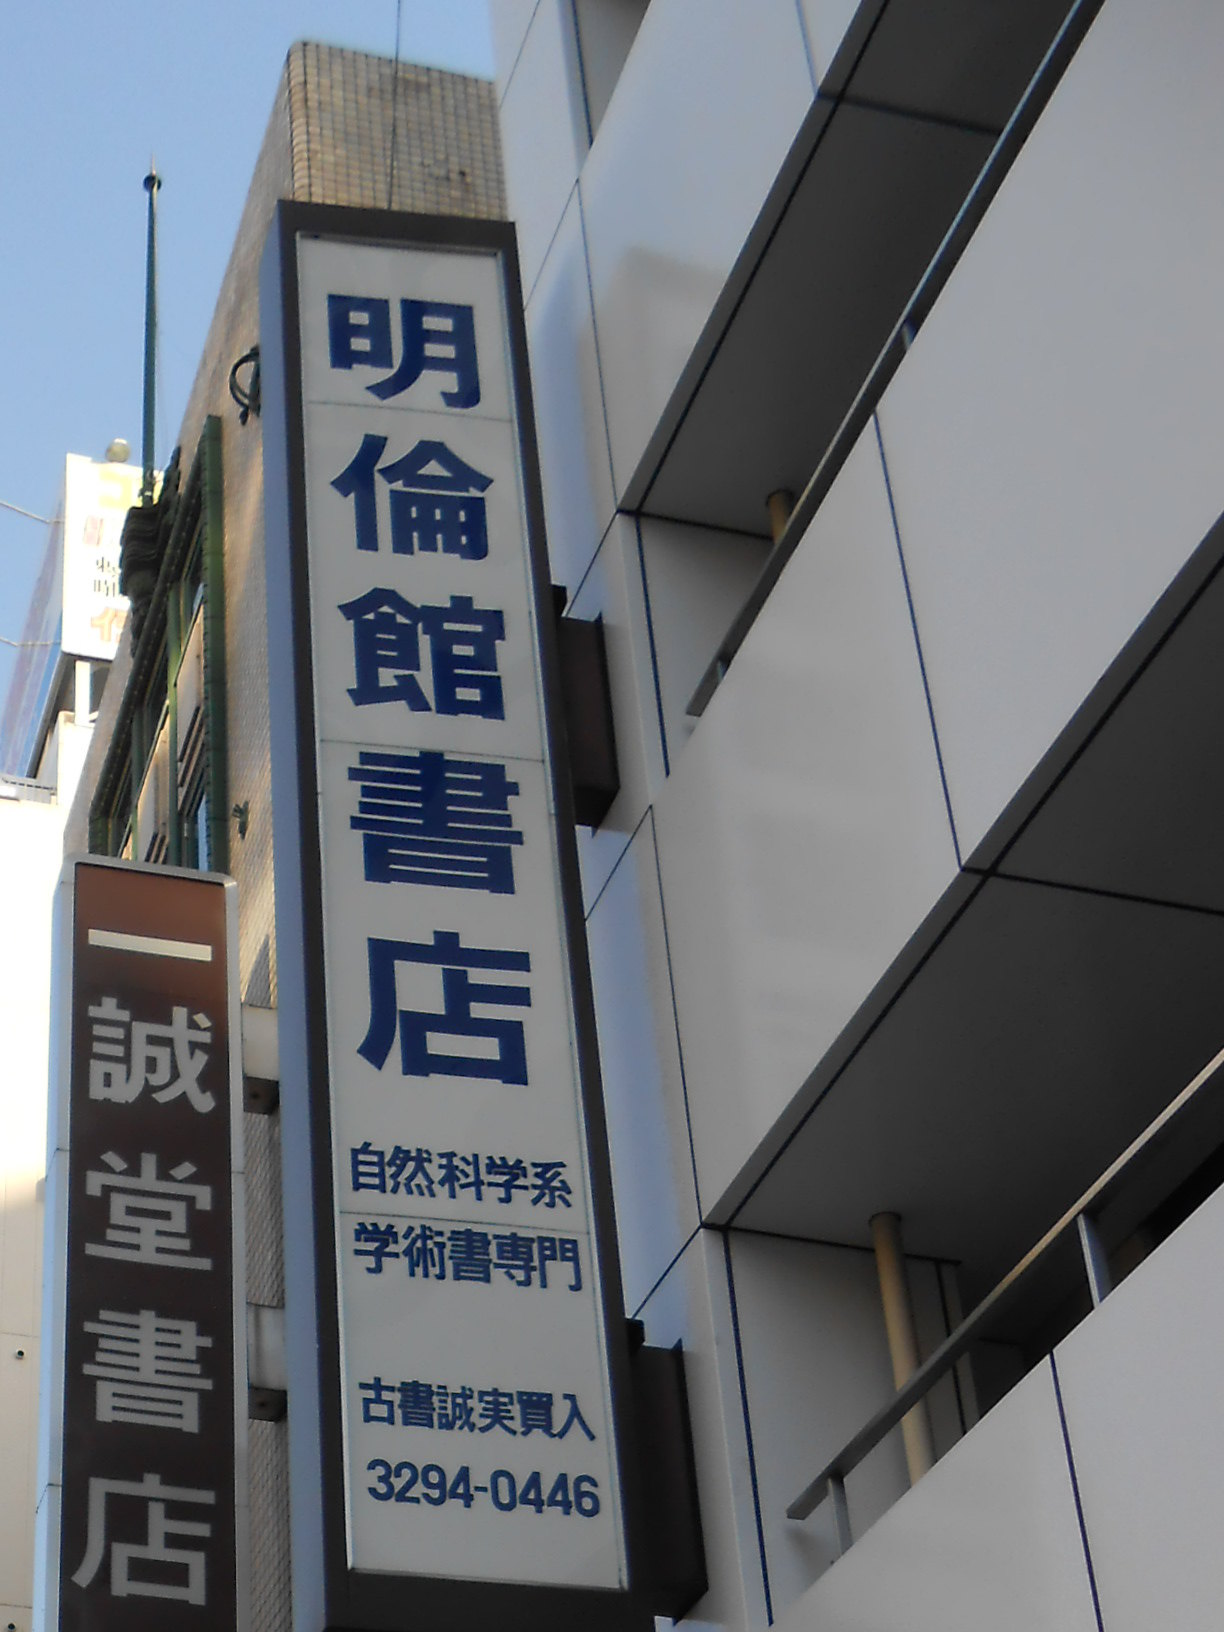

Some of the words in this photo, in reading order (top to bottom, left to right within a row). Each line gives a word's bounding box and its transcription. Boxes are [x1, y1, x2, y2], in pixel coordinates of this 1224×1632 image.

[327, 293, 531, 1085] 明倫館書店
[349, 1141, 572, 1208] 自然科学系
[72, 930, 217, 1606] 一誠堂書店
[354, 1222, 582, 1291] 学術書専門
[359, 1377, 595, 1440] 古書誠実買入
[367, 1459, 600, 1518] 3294-0446
